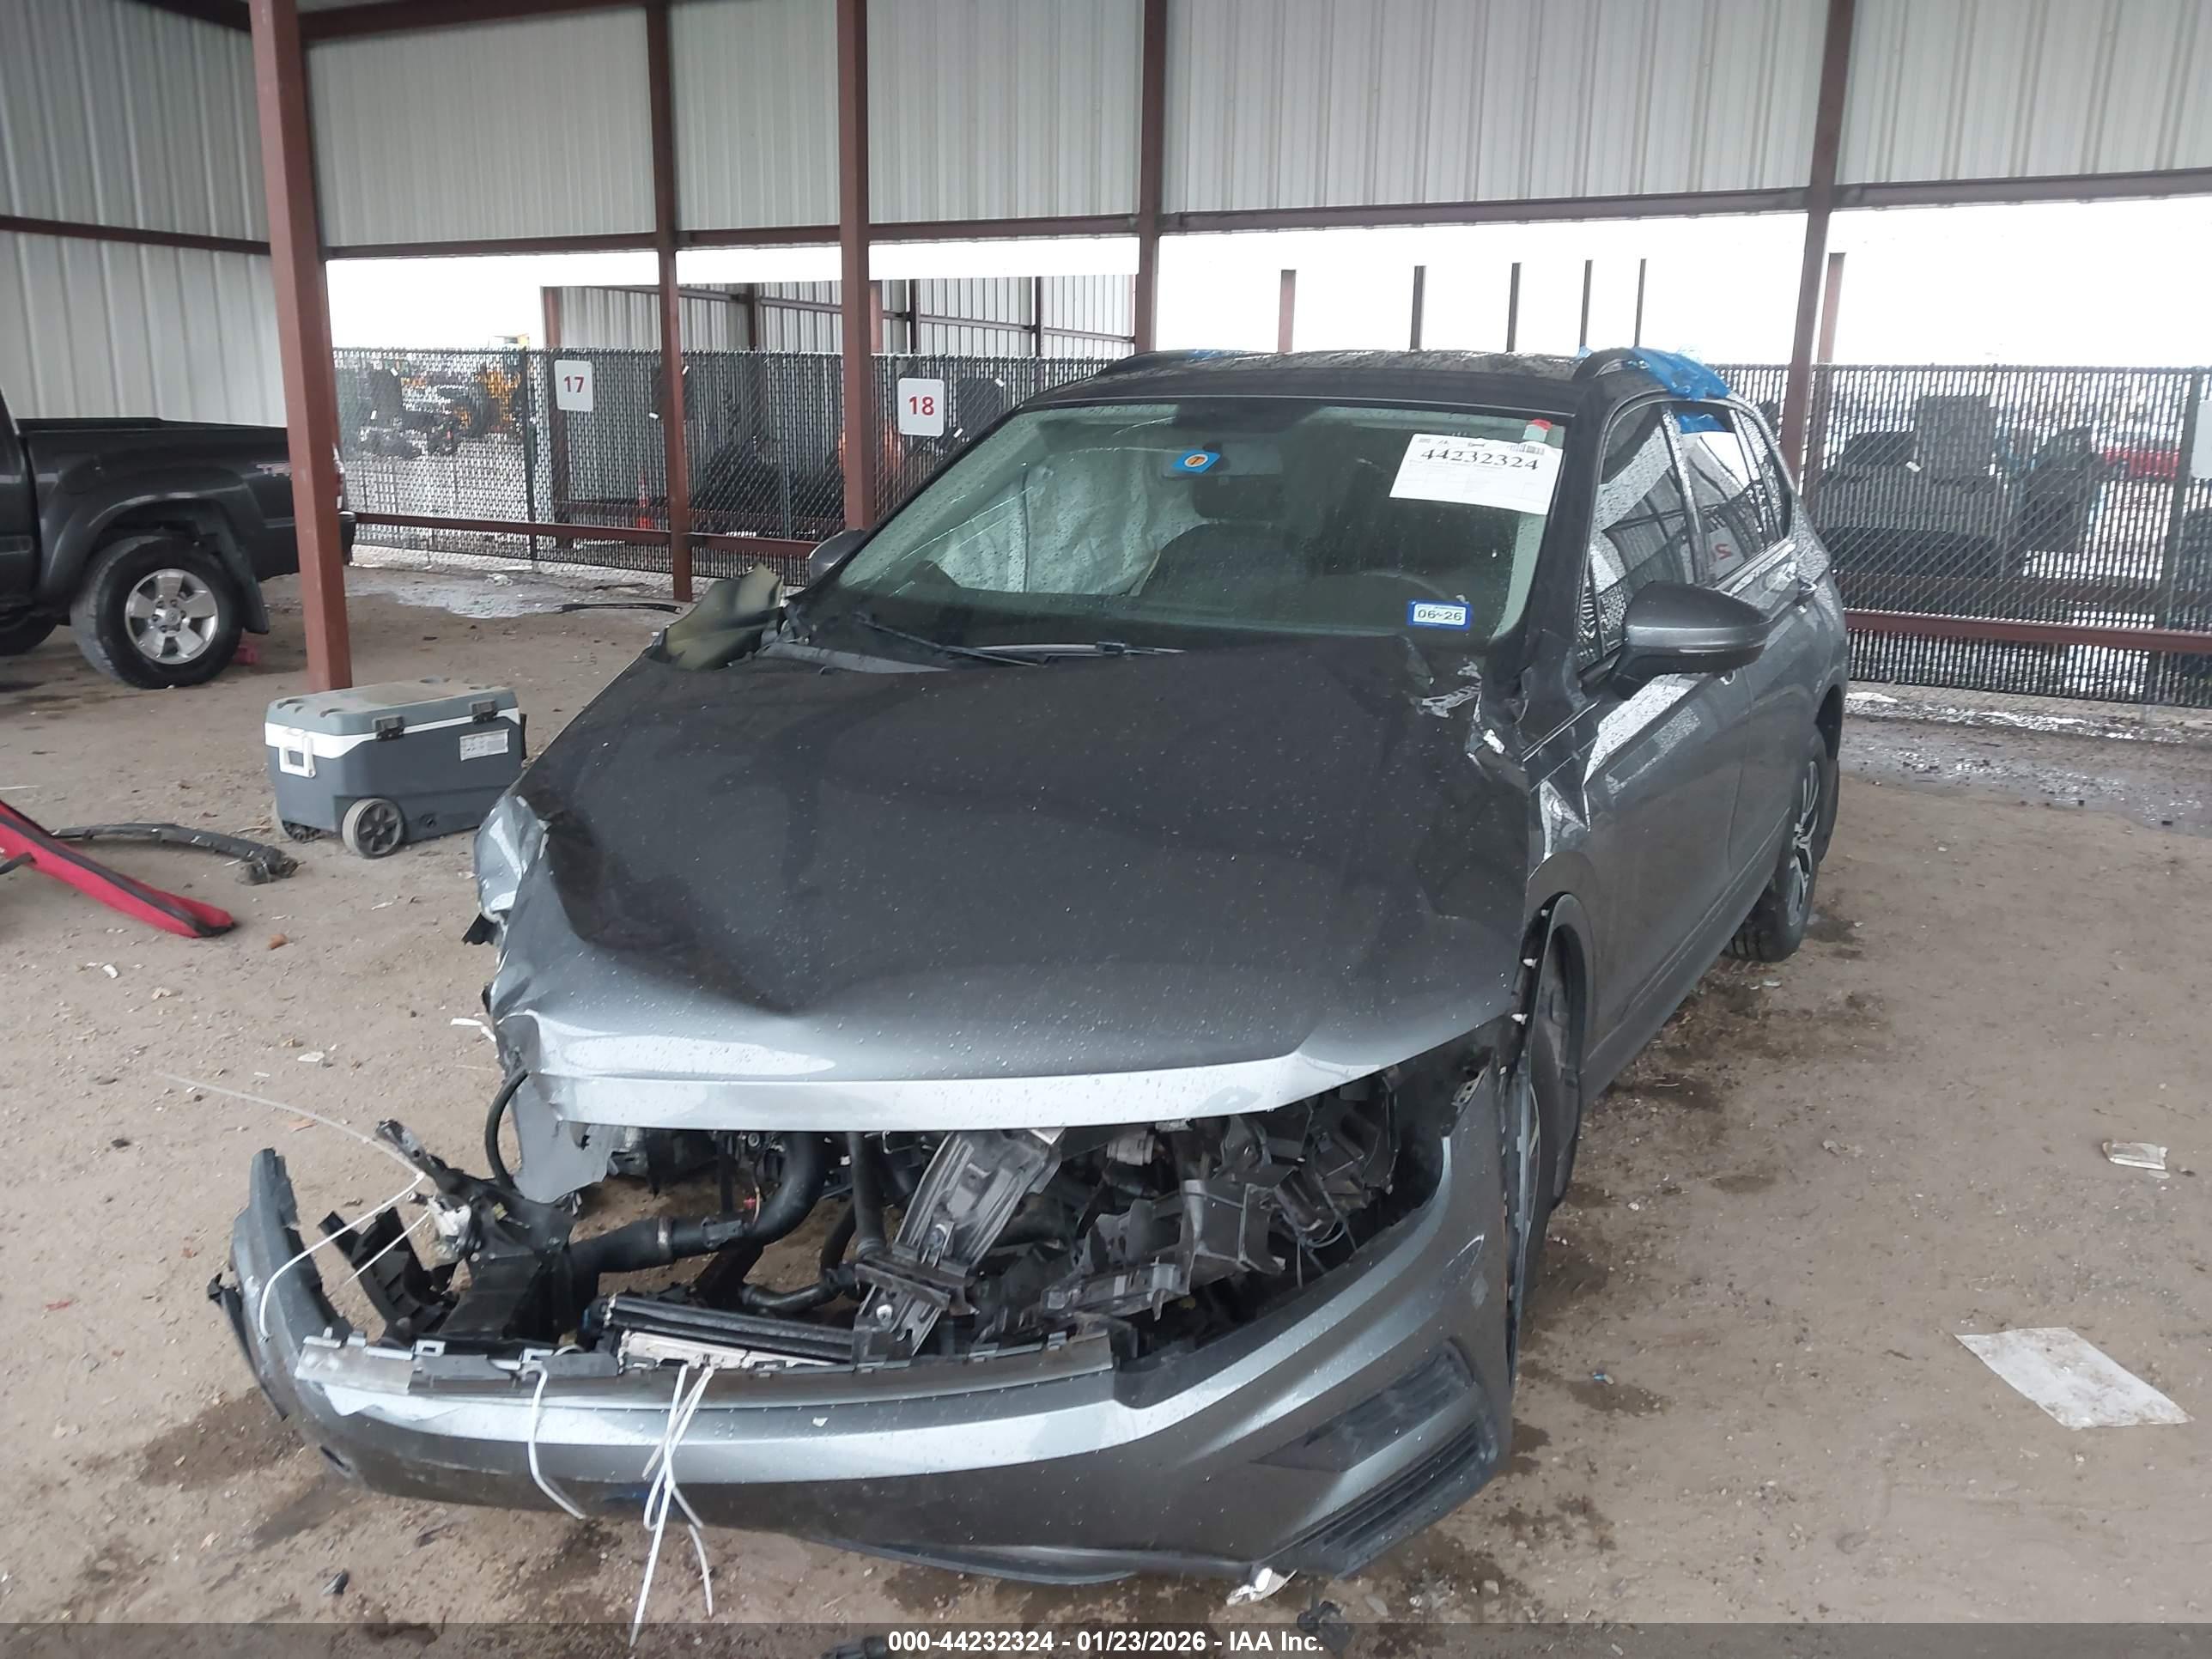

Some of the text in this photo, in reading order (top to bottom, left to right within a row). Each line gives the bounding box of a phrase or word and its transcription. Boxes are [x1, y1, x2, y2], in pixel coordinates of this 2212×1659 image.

[563, 376, 585, 392] 17
[908, 396, 934, 416] 18
[1420, 448, 1540, 471] 44232324
